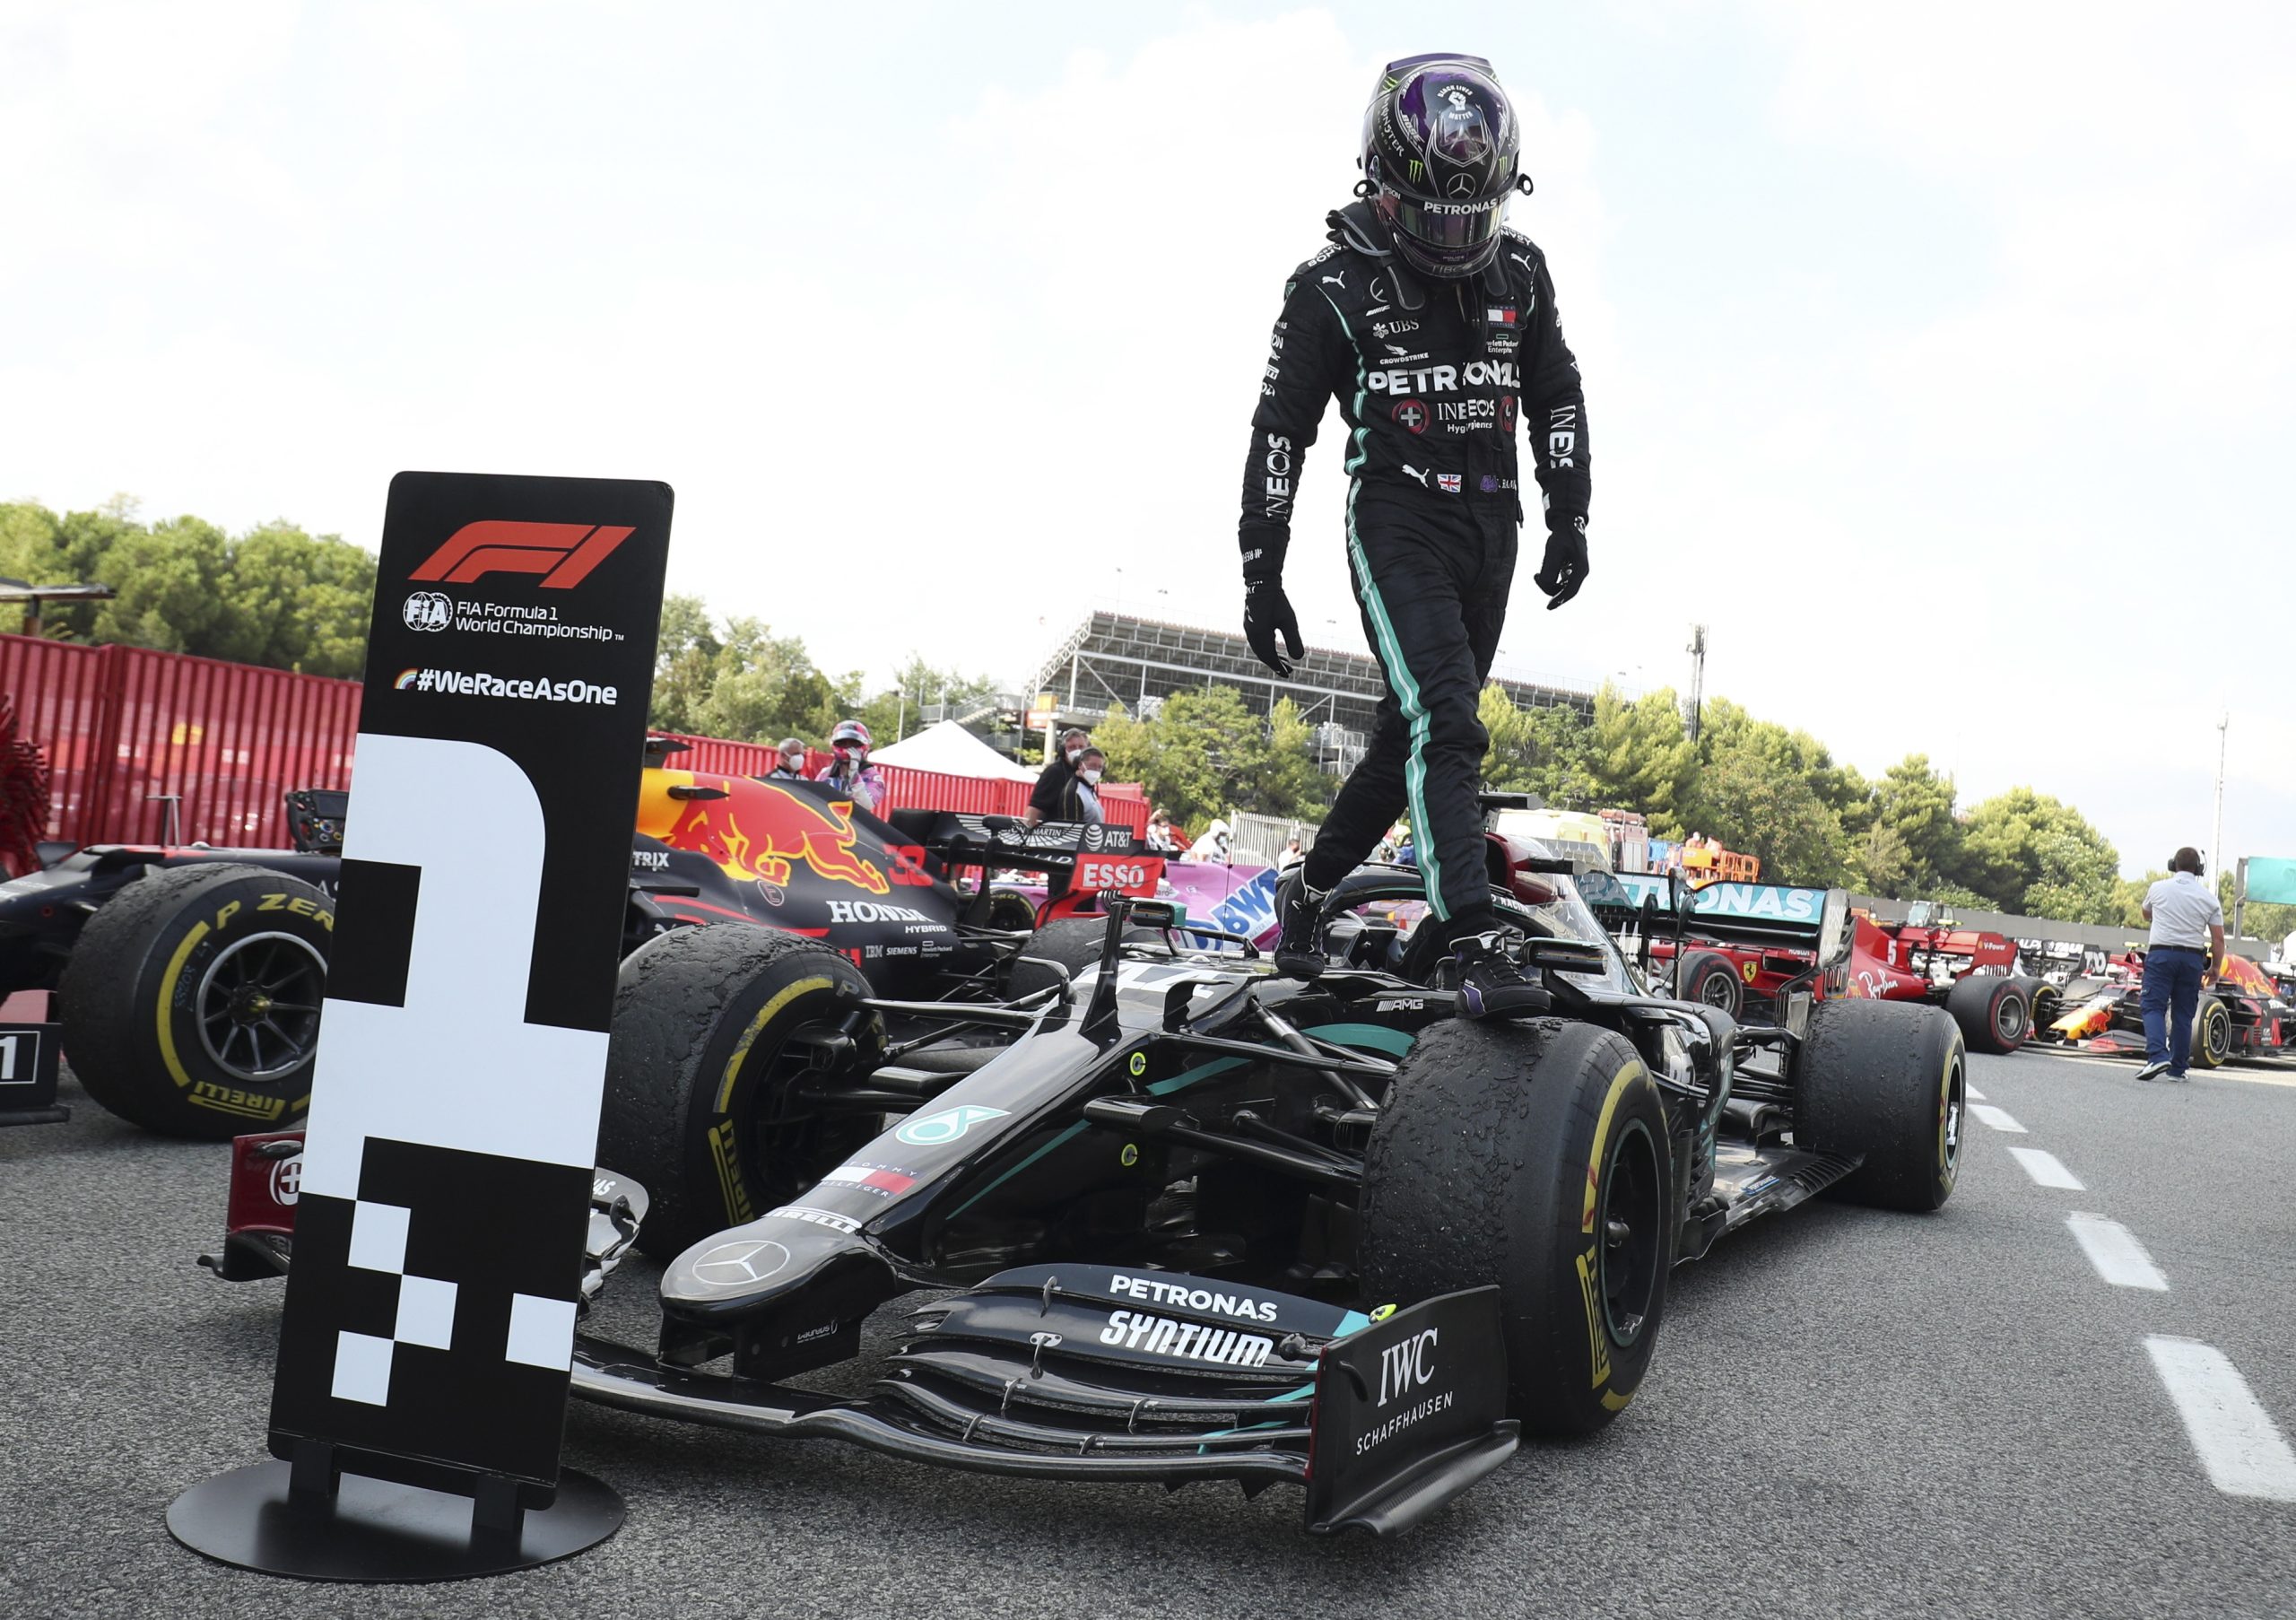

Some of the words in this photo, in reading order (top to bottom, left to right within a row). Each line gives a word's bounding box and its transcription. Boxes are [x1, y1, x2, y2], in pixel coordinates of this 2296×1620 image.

[1448, 110, 1474, 120] MATTER
[1382, 182, 1401, 200] EPSON
[1423, 197, 1497, 215] PETRONAS
[1388, 318, 1420, 335] UBS
[1379, 352, 1430, 365] CROWDSTRIKE
[456, 601, 482, 616] FIA
[484, 603, 548, 620] Formula
[549, 606, 559, 621] 1
[455, 616, 500, 633] World
[502, 620, 613, 642] Championship
[416, 667, 618, 706] #WeRaceAsOne
[1032, 827, 1062, 838] MARTIN
[1104, 831, 1133, 849] AT&T
[632, 850, 670, 868] TRIX
[1082, 862, 1145, 889] ESSO
[216, 900, 241, 930] P
[257, 893, 335, 932] ZER
[826, 900, 936, 924] HONDA
[904, 925, 948, 934] HYBRID
[865, 945, 883, 959] IBM
[886, 946, 918, 956] SIEMENS
[1887, 939, 1898, 965] 5
[1983, 942, 2007, 952] V-Power
[1389, 998, 1424, 1011] AMG
[187, 1080, 287, 1121] PIRELLI
[848, 1161, 918, 1177] TOMMY
[820, 1180, 890, 1198] HILFIGER
[760, 1206, 863, 1234] PIRELLI
[1109, 1274, 1278, 1322] PETRONAS
[1100, 1310, 1274, 1368] SYNTIUM
[1377, 1328, 1439, 1408] IWC
[1355, 1390, 1454, 1456] SCHAFFHAUSEN
